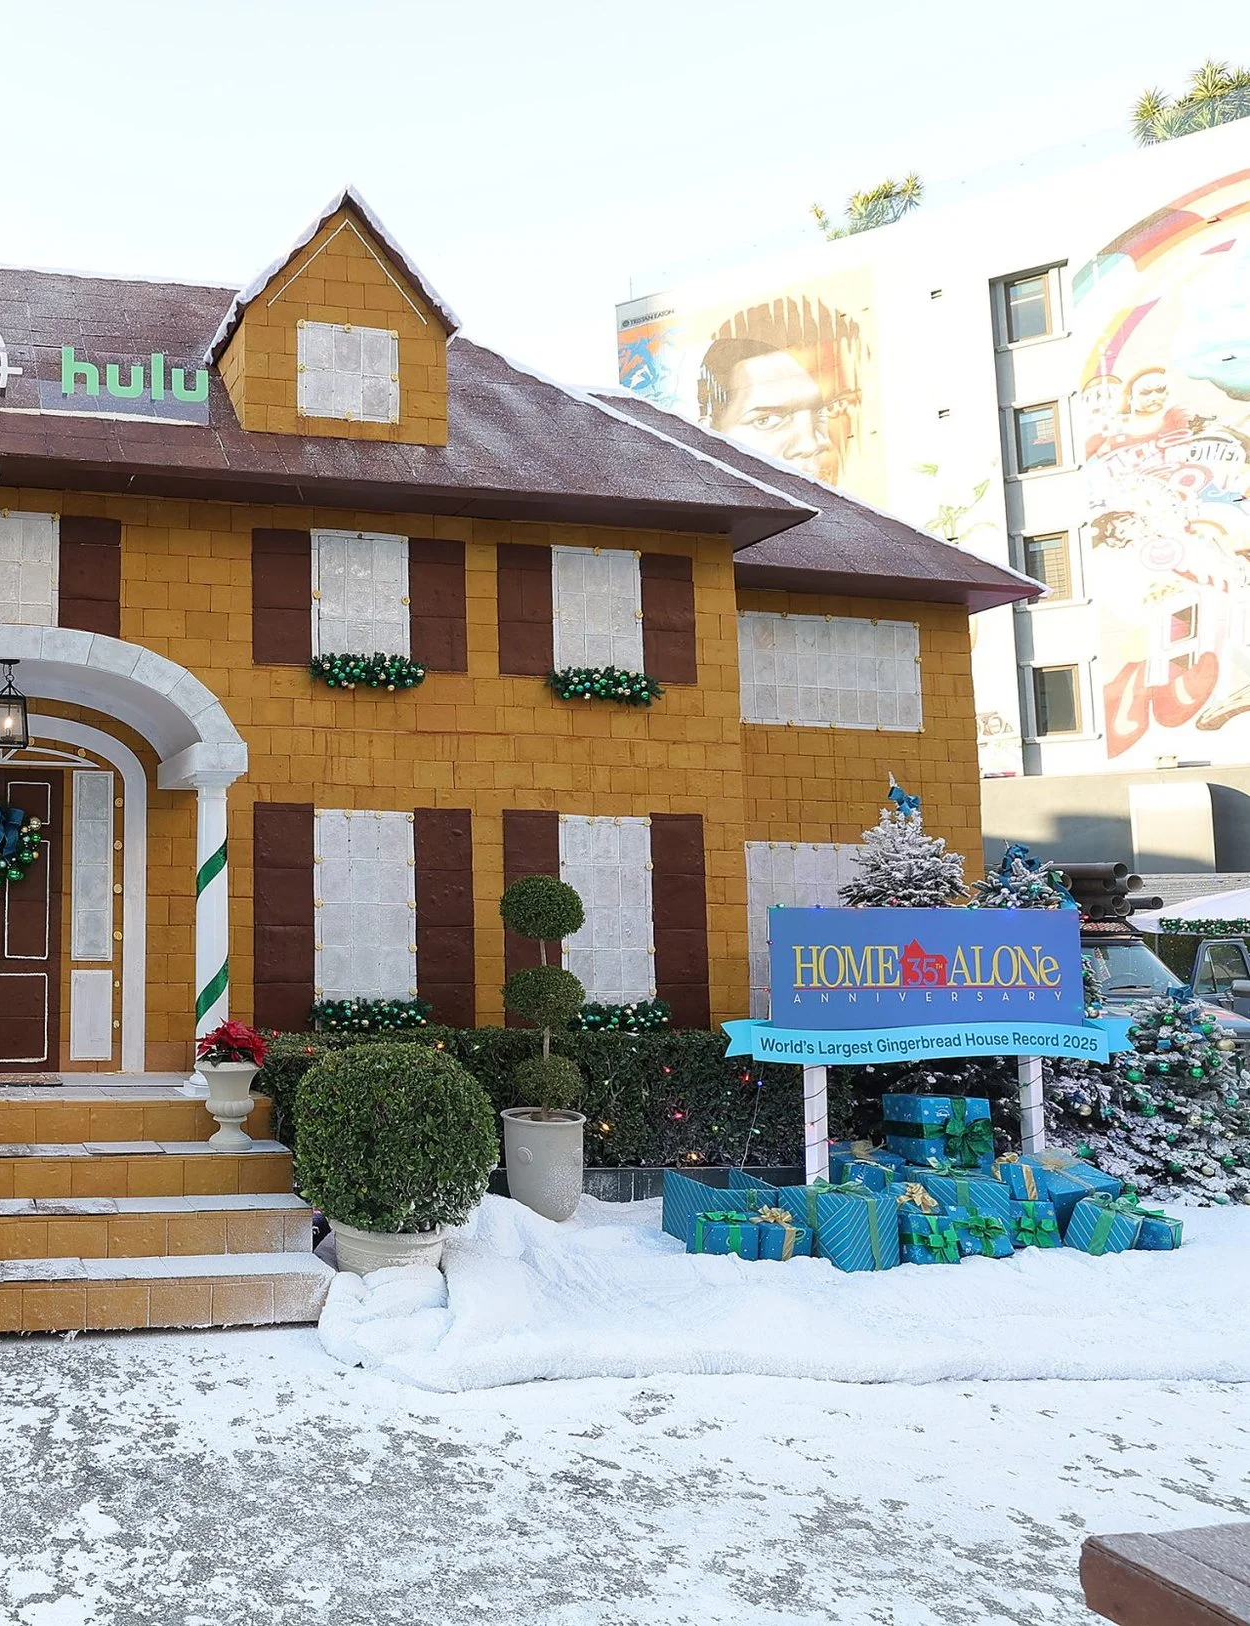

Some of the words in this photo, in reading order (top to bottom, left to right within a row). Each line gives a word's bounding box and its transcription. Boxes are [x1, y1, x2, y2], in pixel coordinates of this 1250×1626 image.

[61, 346, 209, 402] hulu
[792, 945, 900, 987] HOME
[793, 991, 1062, 1003] ANNIVERSARY
[760, 1037, 814, 1053] World's
[818, 1040, 874, 1057] Largest
[876, 1034, 961, 1054] Gingerbread
[965, 1032, 1009, 1047] House
[1013, 1031, 1059, 1047] Record
[1063, 1035, 1098, 1051] 2025
